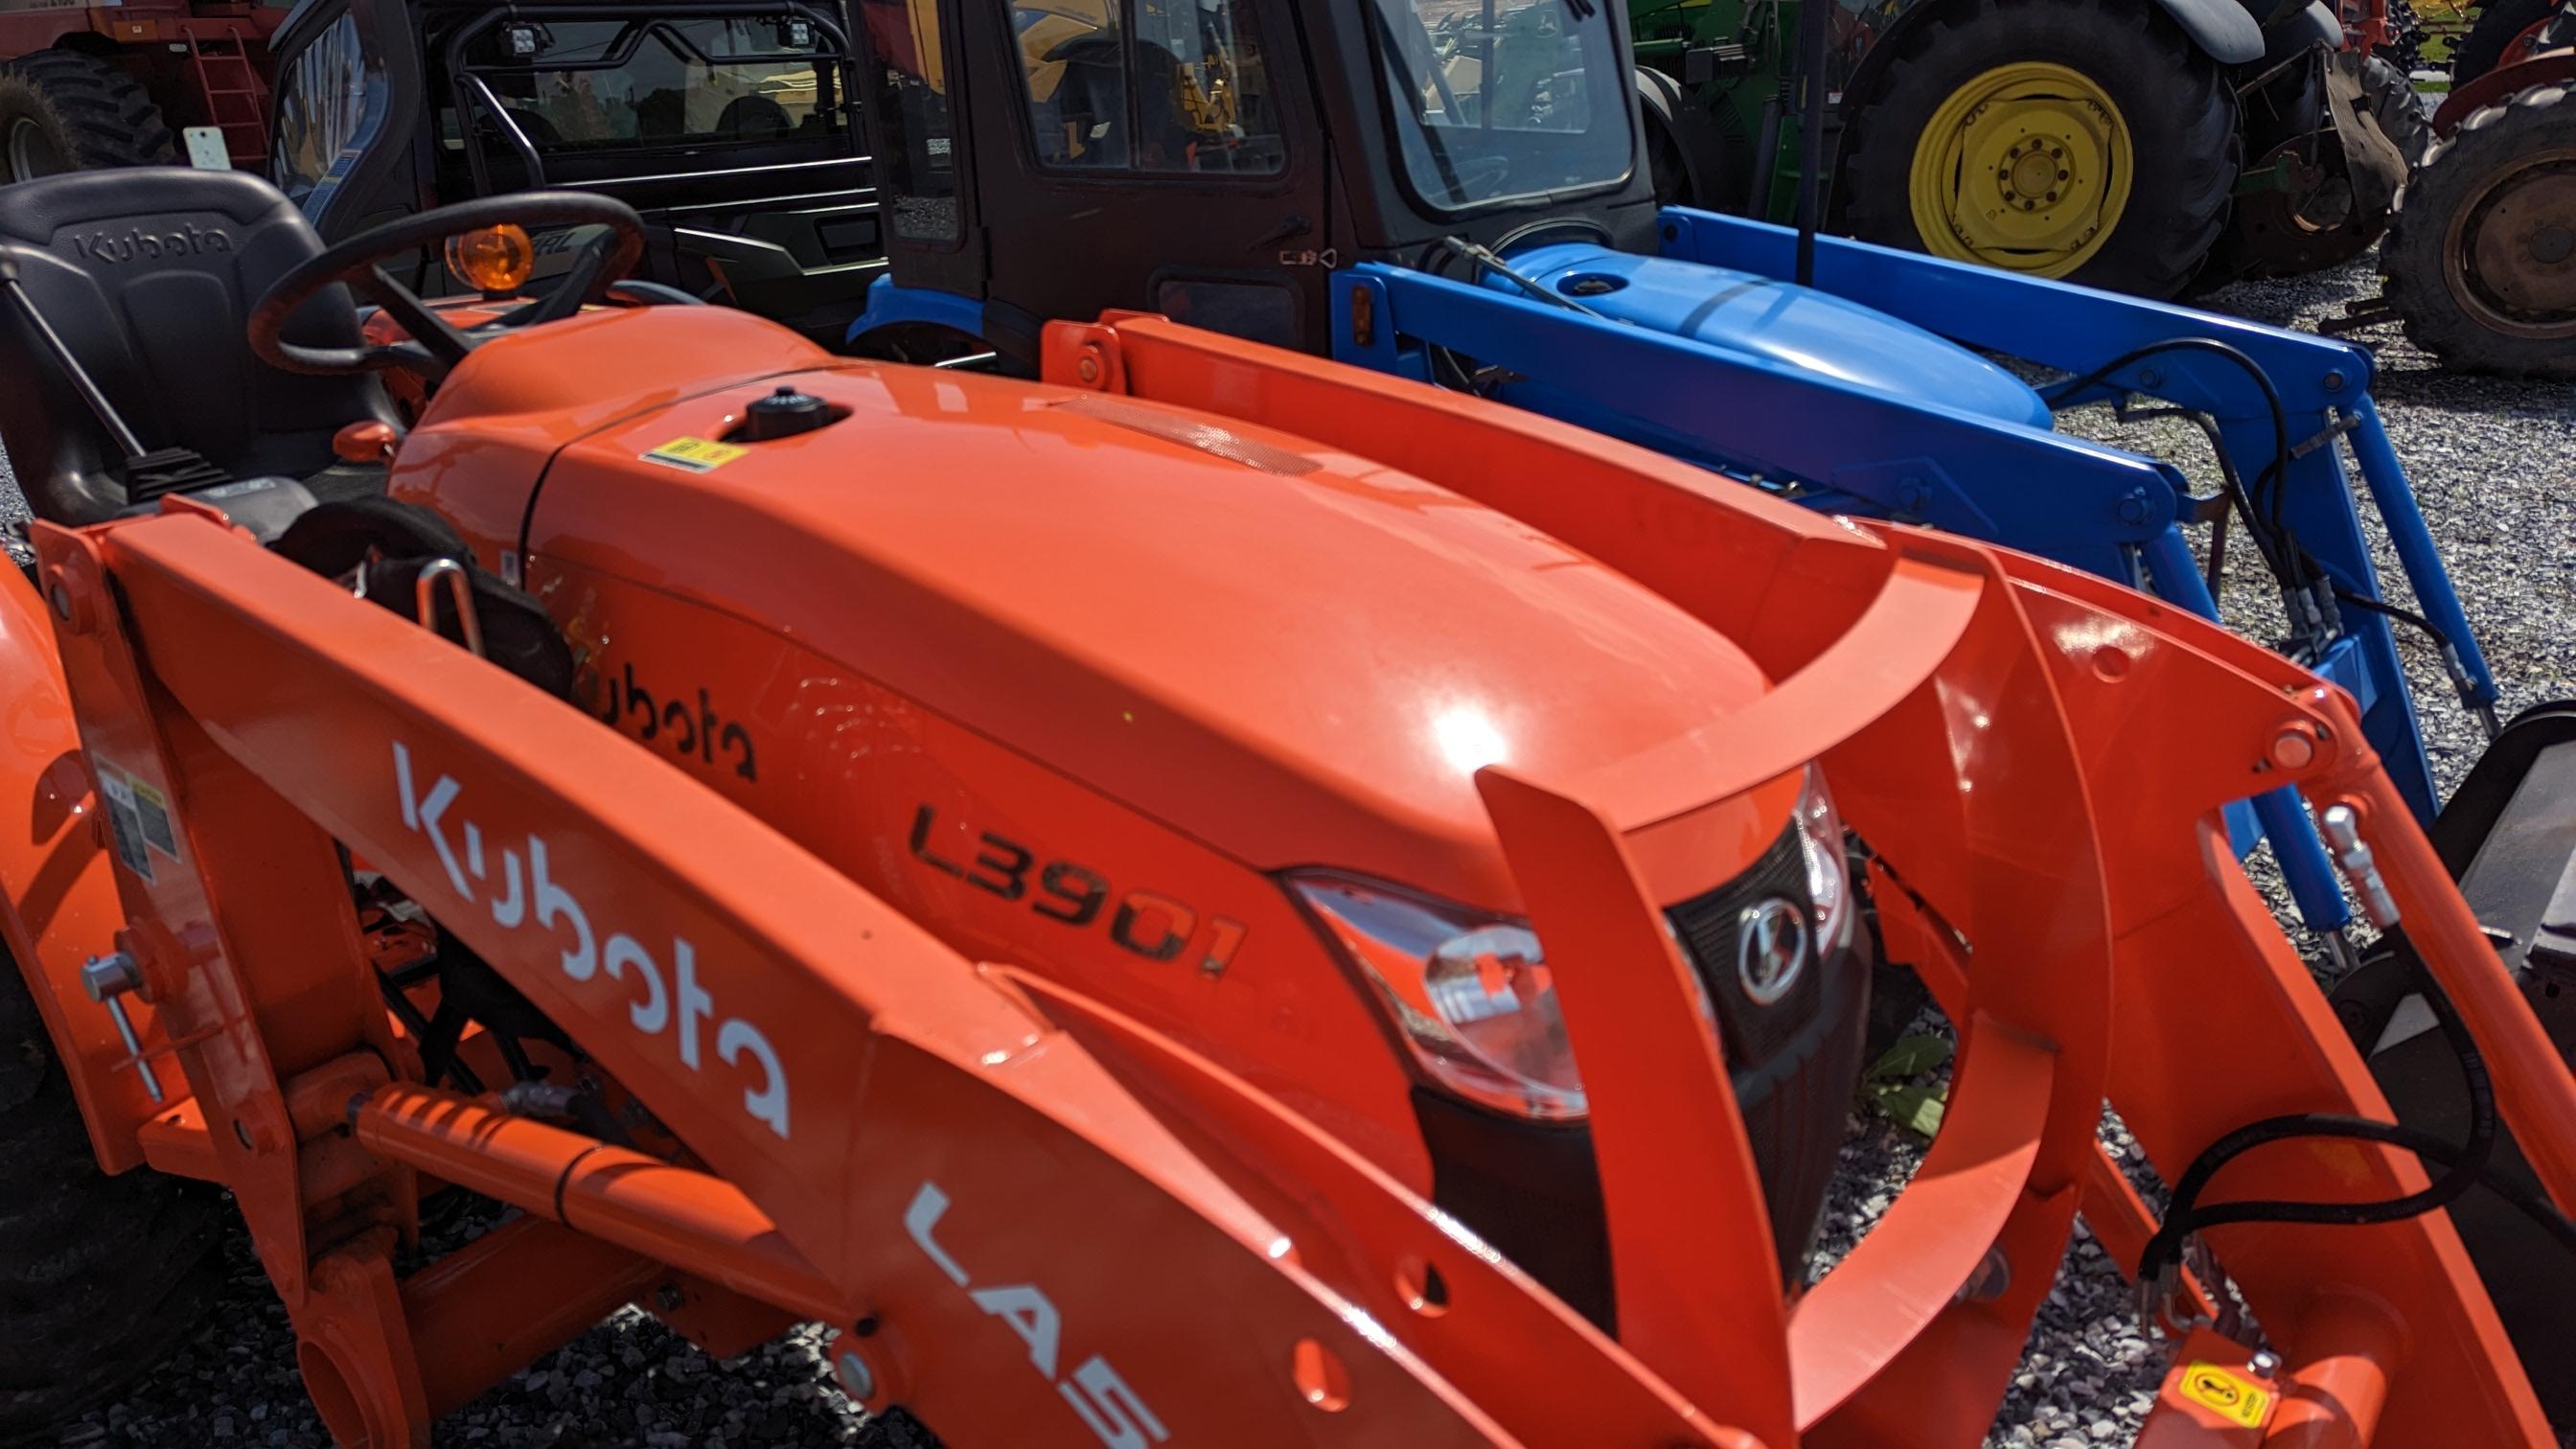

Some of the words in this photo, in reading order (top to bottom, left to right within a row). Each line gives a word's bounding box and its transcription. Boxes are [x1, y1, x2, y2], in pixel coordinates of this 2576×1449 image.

[73, 222, 231, 264] Kubota
[586, 662, 757, 783] ubota
[383, 740, 790, 1140] Kubota
[908, 802, 1247, 980] L3901
